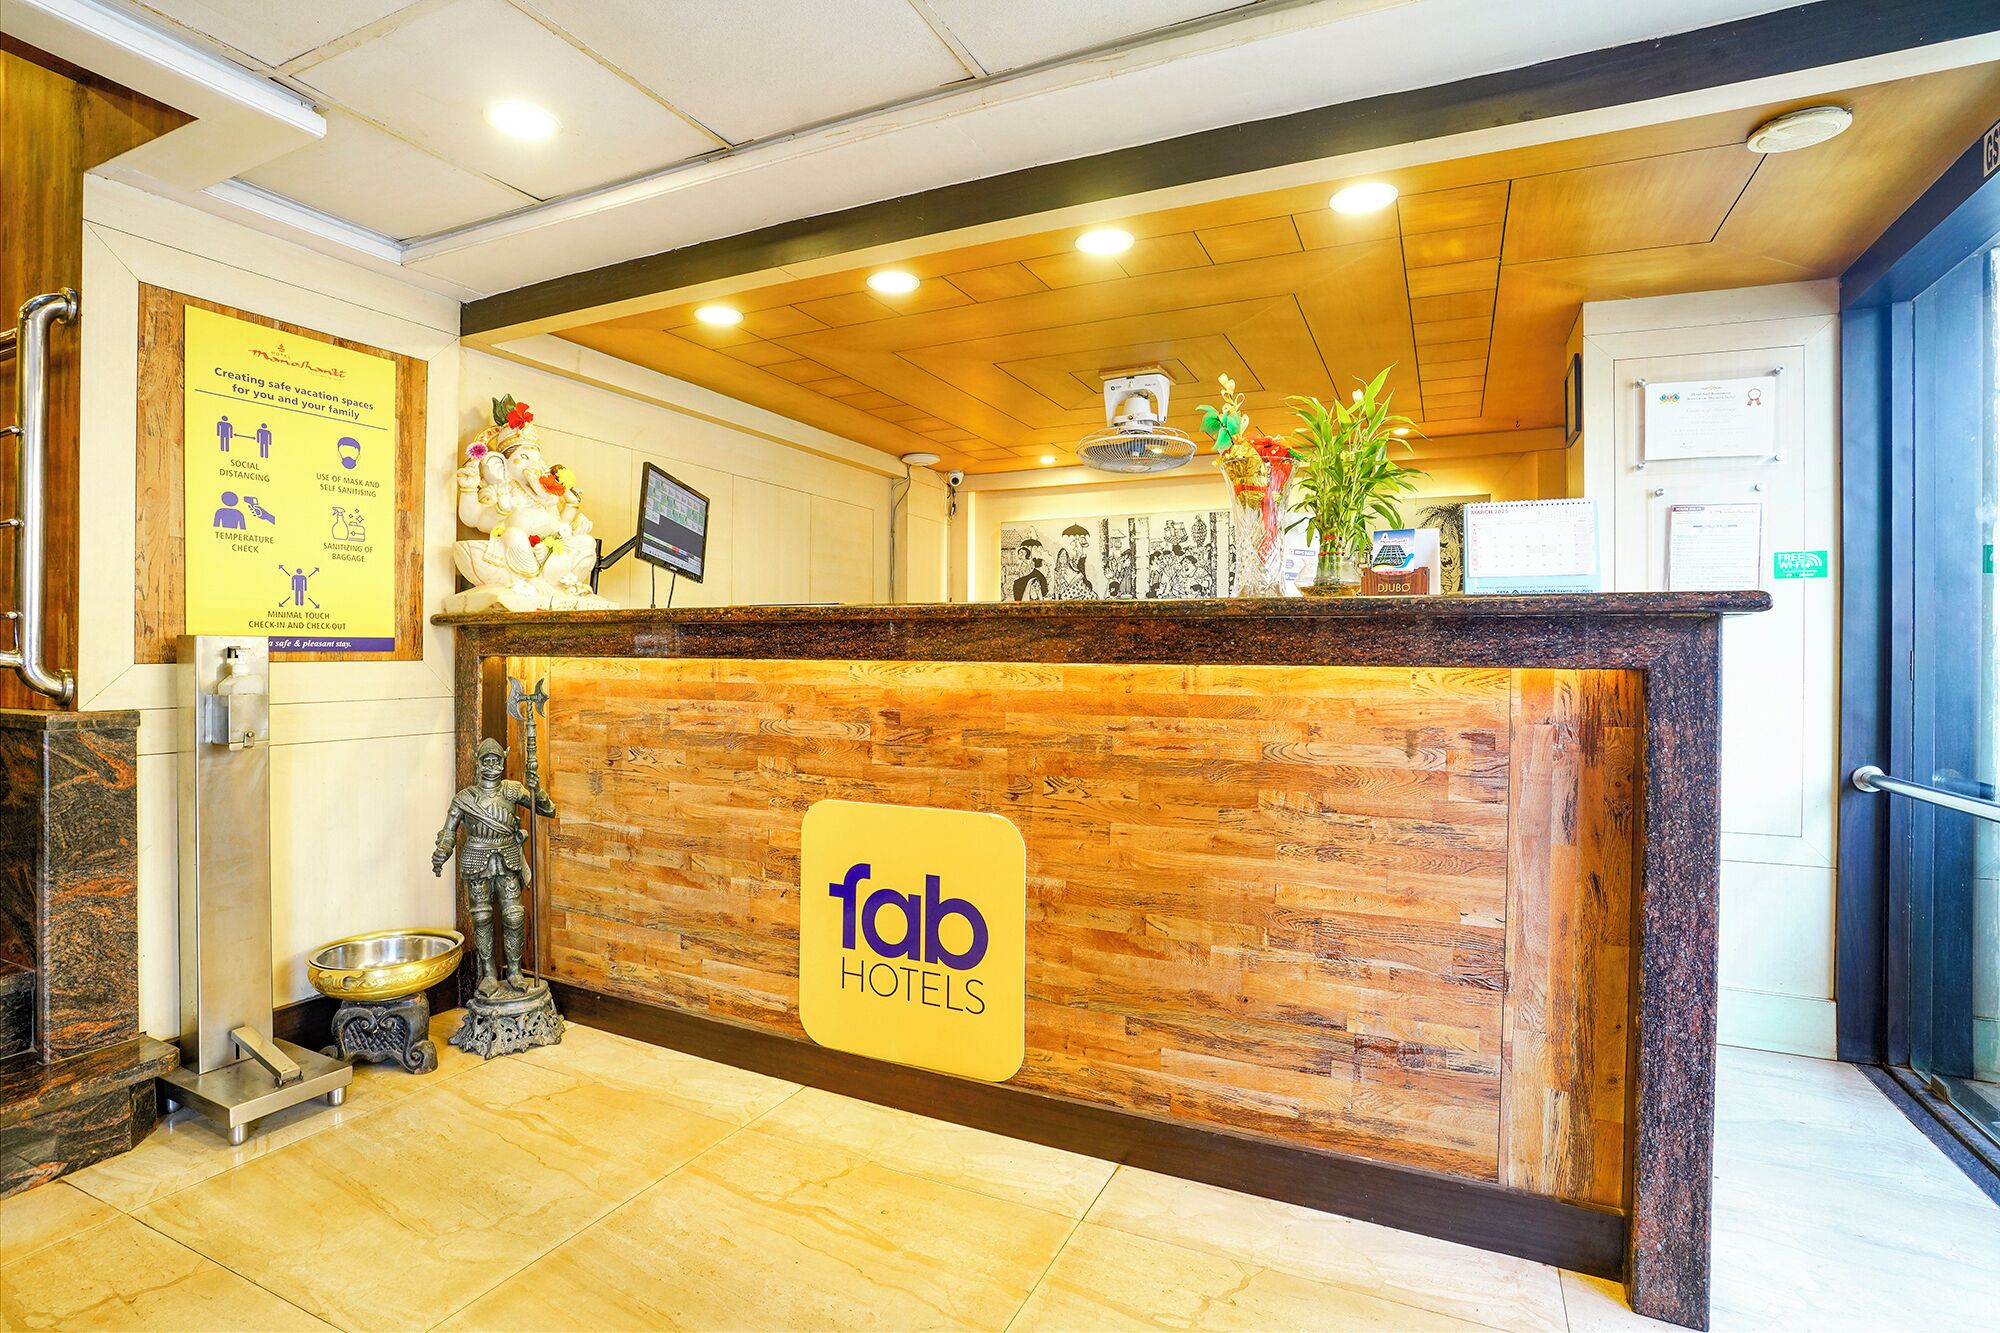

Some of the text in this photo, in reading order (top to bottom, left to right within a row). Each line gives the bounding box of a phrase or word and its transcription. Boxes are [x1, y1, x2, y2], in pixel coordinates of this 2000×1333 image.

[1986, 125, 2000, 171] GS
[214, 367, 374, 411] Creating safe vacation spaces
[232, 383, 360, 420] for you and your family
[230, 458, 260, 471] SOCIAL
[219, 468, 270, 483] DISTANCING
[316, 473, 380, 489] USE OF MASK AND
[319, 483, 377, 498] SELF SANITISING
[214, 531, 274, 545] TEMPERATURE
[231, 543, 259, 553] CHECK
[323, 542, 363, 553] SANITIZING
[331, 553, 366, 562] BAGGAGE
[1777, 553, 1804, 561] FREE
[1377, 583, 1411, 593] DJUBO
[267, 610, 330, 620] MINIMAL TOUCH
[248, 620, 347, 630] CHECK-IN AND CHECK-OUT
[275, 639, 292, 648] safe
[302, 640, 335, 648] pleasant
[335, 641, 352, 649] stay.
[829, 863, 989, 971] fab
[841, 957, 986, 1015] HOTELS
